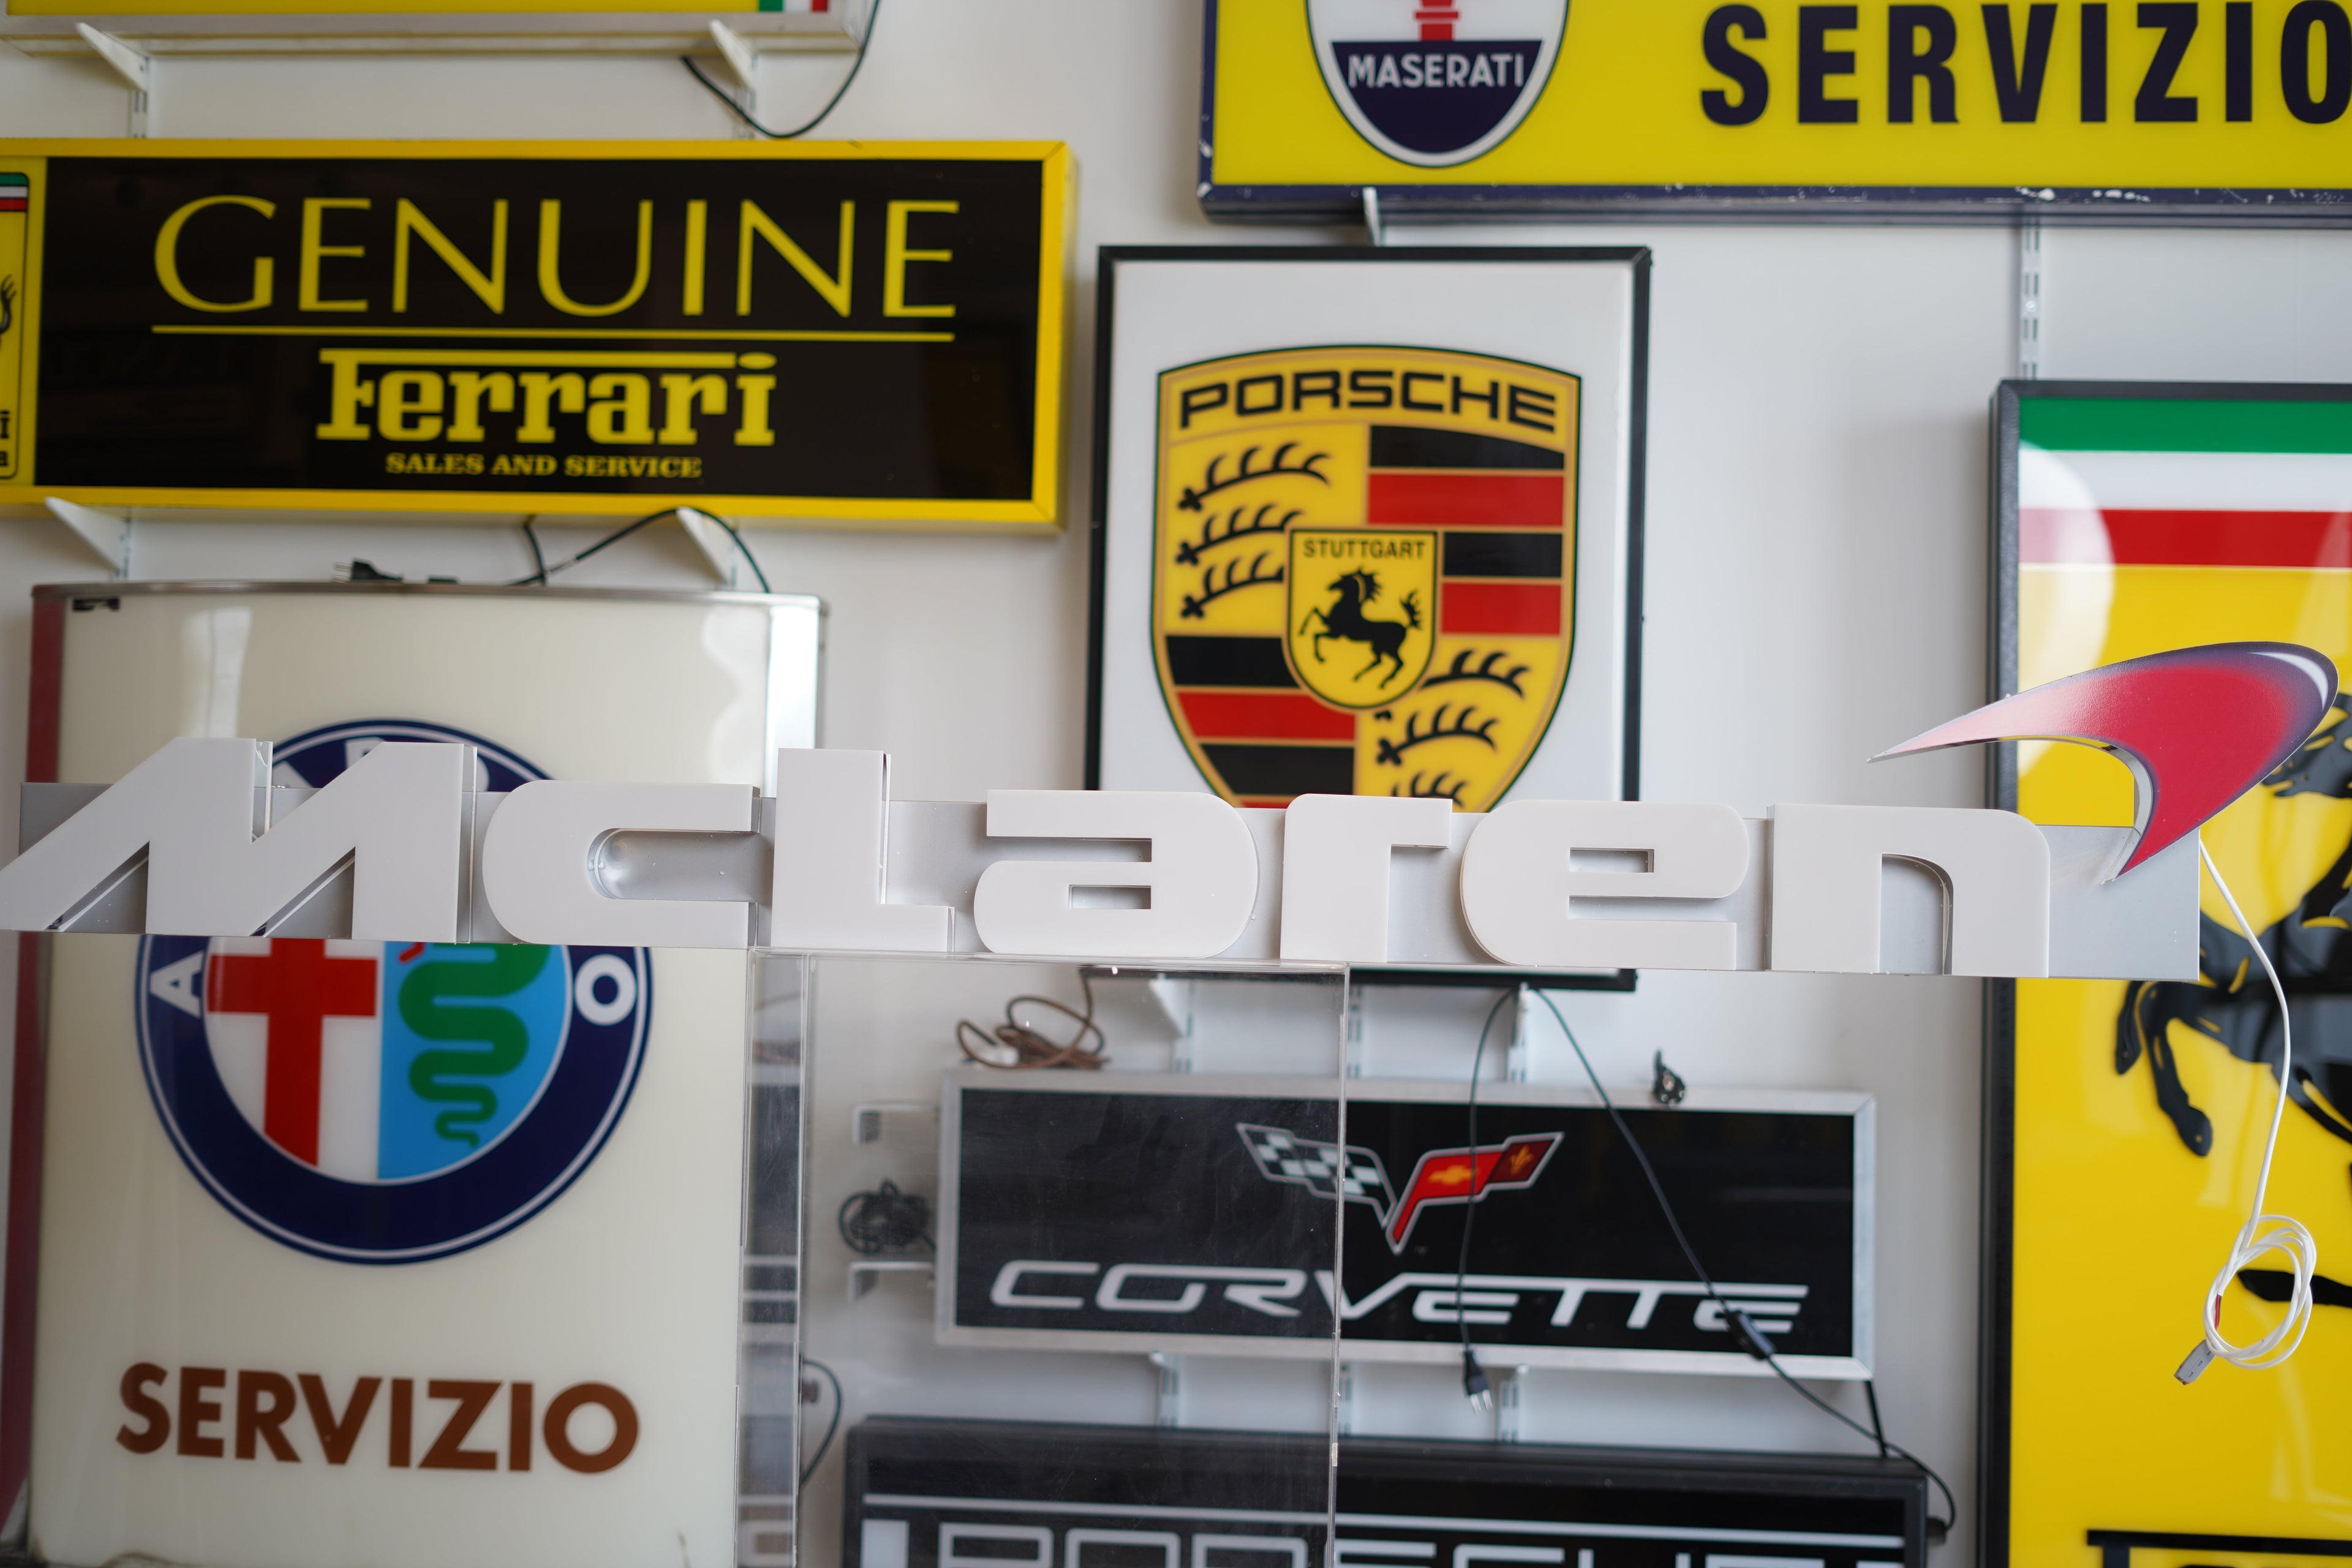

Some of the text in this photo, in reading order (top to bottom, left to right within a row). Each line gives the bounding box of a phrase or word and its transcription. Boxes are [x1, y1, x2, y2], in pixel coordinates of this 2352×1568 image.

[1347, 53, 1525, 88] MASERATI
[1700, 0, 2352, 126] SERVIZIO
[155, 195, 960, 318] GENUINE
[317, 349, 777, 446] Ferrari
[1180, 370, 1556, 433] PORSCHE
[386, 452, 703, 478] SALES AND SERVICE
[1303, 538, 1426, 560] STUTTGART
[0, 737, 2051, 979] McLaren
[990, 1259, 1809, 1333] CORVETTE
[115, 1361, 639, 1474] SERVIZIO
